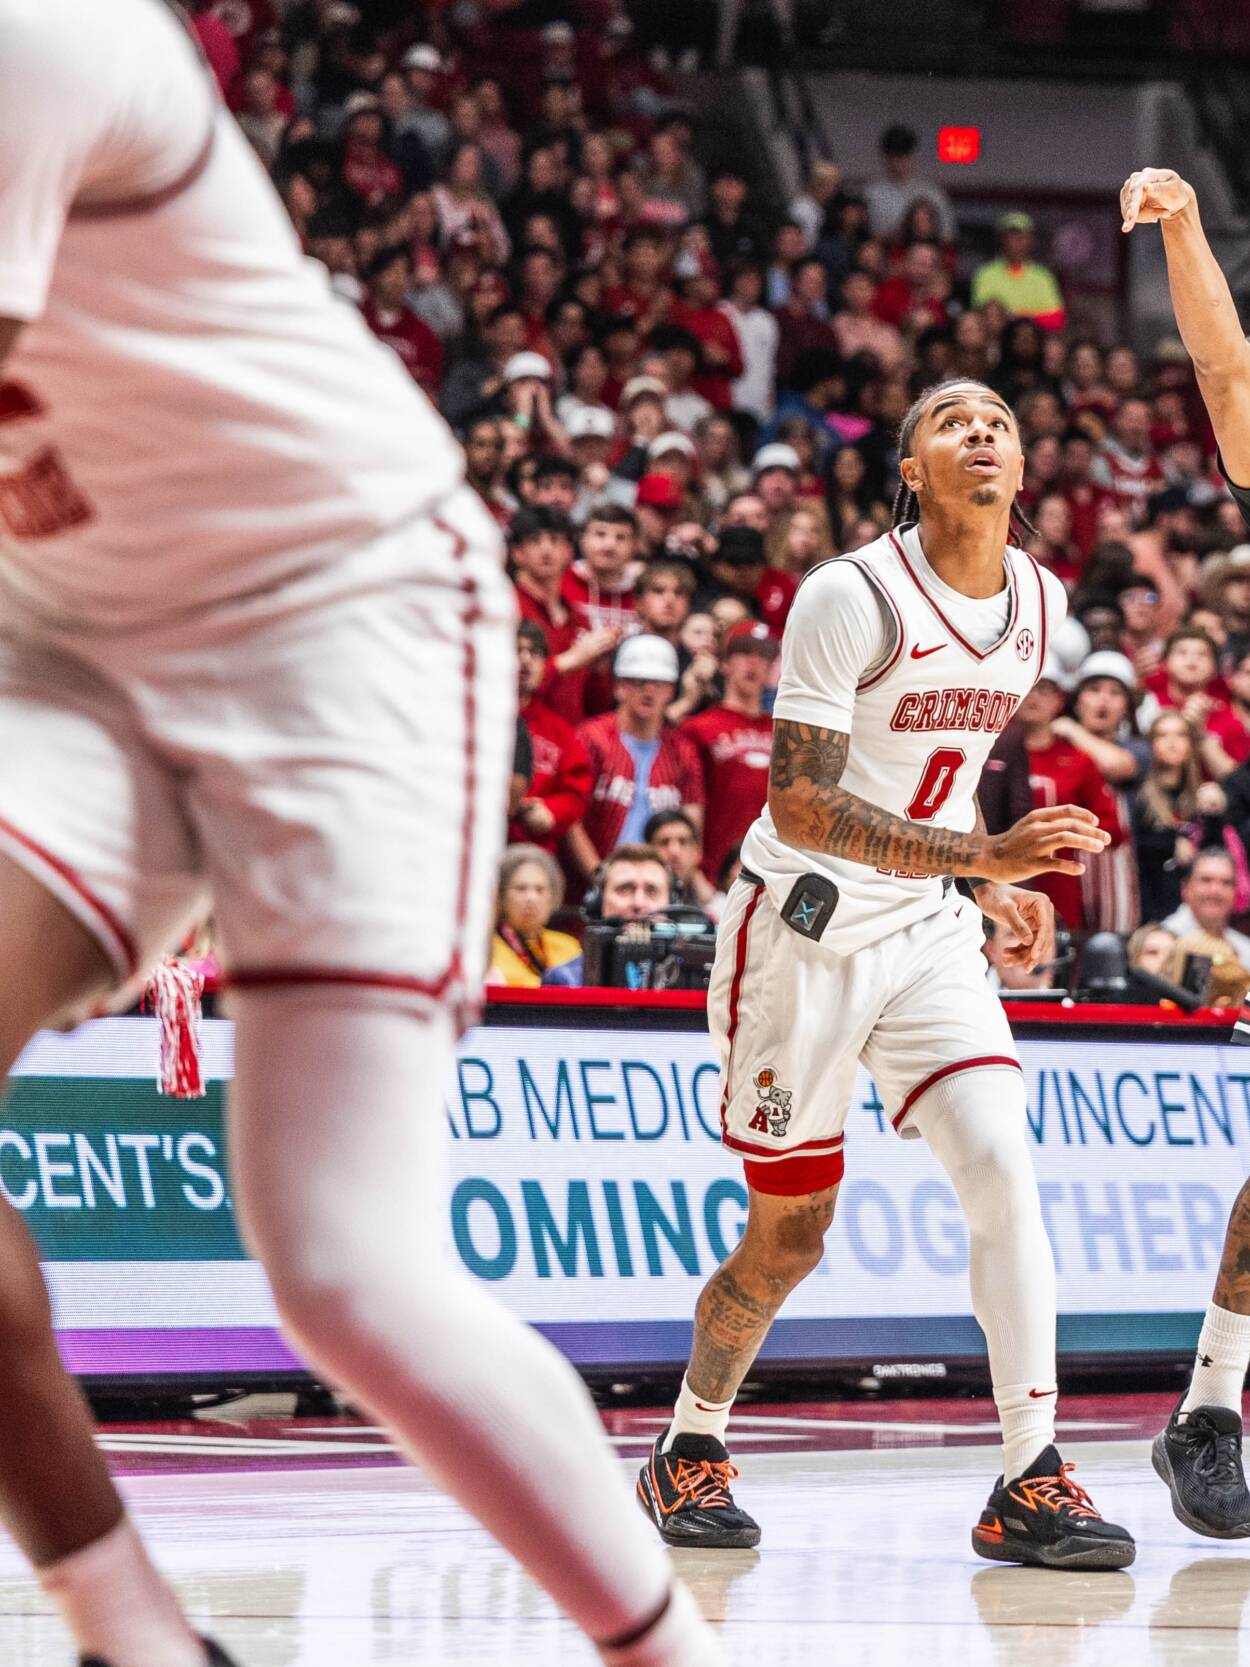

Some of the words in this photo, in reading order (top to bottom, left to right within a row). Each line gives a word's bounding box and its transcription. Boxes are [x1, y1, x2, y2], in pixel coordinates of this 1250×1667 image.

[904, 746, 967, 822] 0
[748, 1106, 768, 1133] A
[450, 1177, 749, 1281] OMING
